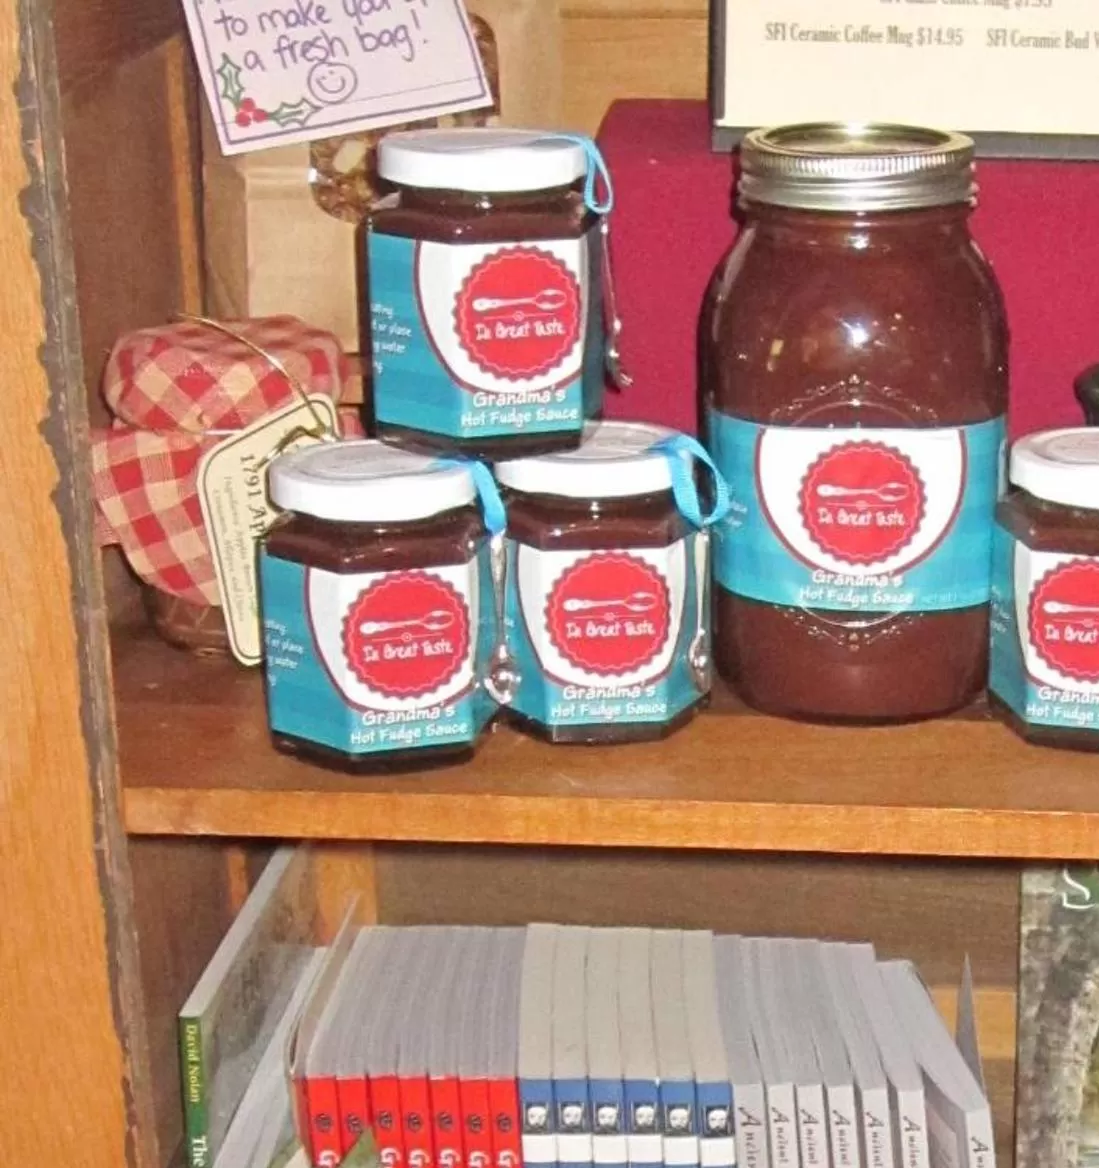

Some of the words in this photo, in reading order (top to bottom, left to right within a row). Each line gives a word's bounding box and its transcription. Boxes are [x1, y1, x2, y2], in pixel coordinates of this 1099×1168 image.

[214, 9, 248, 41] to
[258, 0, 332, 33] make
[244, 50, 266, 72] a
[274, 29, 348, 70] fresh
[354, 8, 428, 62] bag!
[765, 22, 787, 41] SFI
[790, 23, 840, 42] Ceramic
[844, 25, 884, 44] Coffee
[887, 26, 914, 48] Mug
[916, 26, 964, 46] $14.95
[986, 28, 1008, 48] SFI
[1010, 29, 1061, 48] Ceramic
[1065, 30, 1090, 49] Bud
[495, 322, 531, 339] Great
[472, 386, 567, 408] Grandma's
[460, 411, 486, 427] Hot
[490, 410, 532, 428] Fudge
[536, 406, 579, 421] Sauce
[240, 454, 262, 497] 1791
[812, 569, 903, 587] Grandma's
[799, 587, 823, 600] Hot
[826, 589, 868, 606] Fudge
[872, 590, 915, 604] Sauce
[384, 644, 418, 660] Great
[562, 682, 656, 700] Grandma's
[362, 702, 455, 726] Grandma's
[552, 706, 576, 718] Hot
[580, 704, 621, 719] Fudge
[626, 702, 667, 715] Sauce
[1026, 705, 1050, 718] Hot
[1053, 707, 1094, 724] Fudge
[351, 730, 375, 744] Hot
[380, 727, 421, 744] Fudge
[426, 722, 468, 737] Sauce
[186, 1024, 199, 1060] David
[191, 1135, 208, 1167] The
